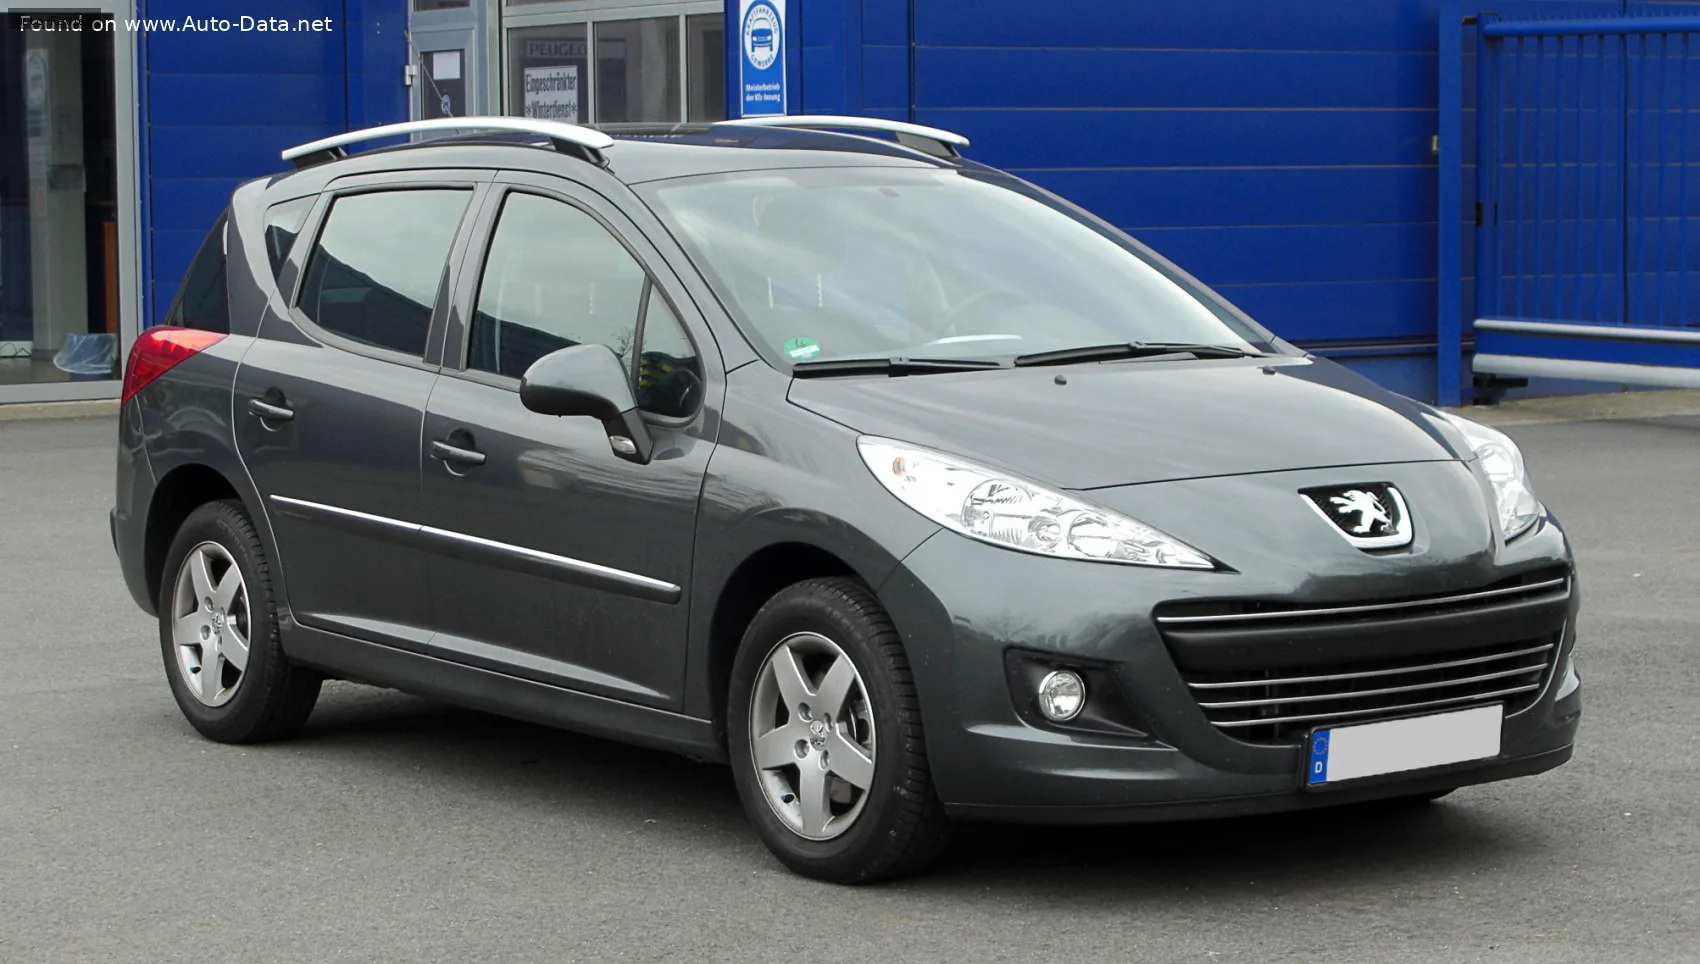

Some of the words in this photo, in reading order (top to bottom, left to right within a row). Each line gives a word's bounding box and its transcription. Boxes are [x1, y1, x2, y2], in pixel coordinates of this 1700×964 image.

[529, 42, 588, 56] PEUGEO
[525, 72, 577, 95] Eingeschränkter
[1314, 761, 1323, 774] D
